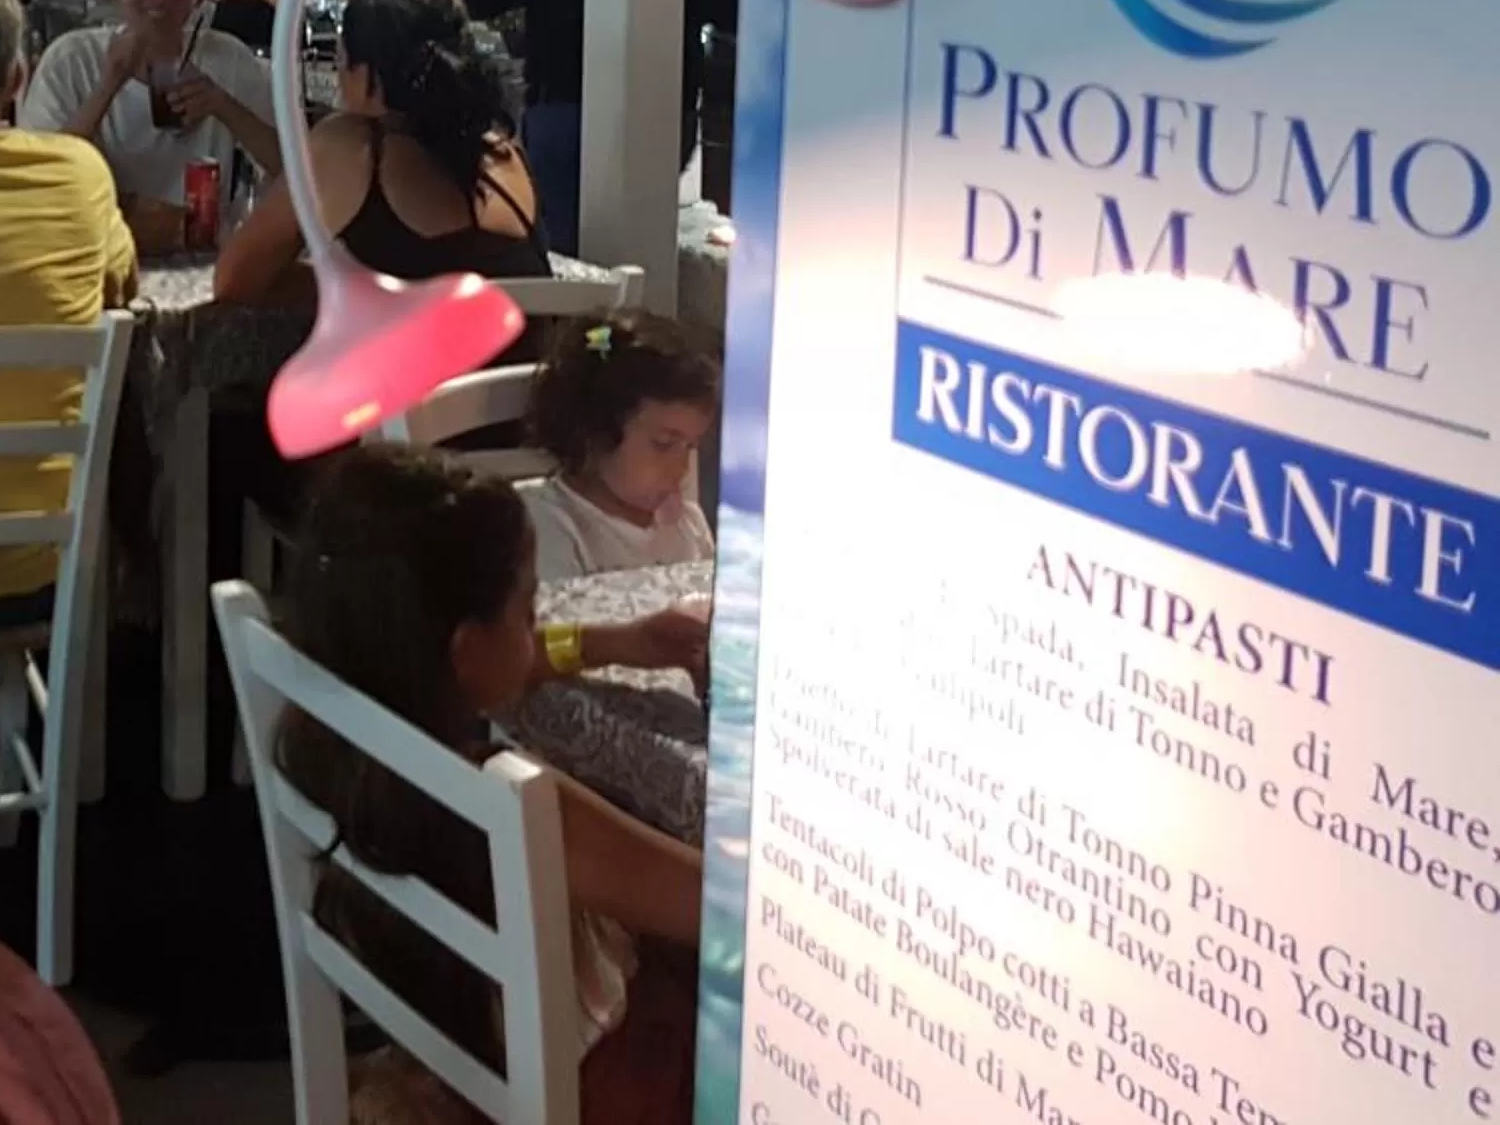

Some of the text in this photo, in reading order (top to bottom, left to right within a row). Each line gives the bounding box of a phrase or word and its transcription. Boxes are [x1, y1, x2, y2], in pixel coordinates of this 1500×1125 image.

[935, 40, 1492, 241] PROFUMO
[915, 344, 1477, 613] RISTORANTE
[1026, 542, 1336, 708] ANTIPASTI
[1084, 689, 1116, 732] di
[1129, 705, 1248, 794] Tonno
[1259, 779, 1280, 809] e
[1292, 785, 1500, 915] Gambero
[1118, 651, 1256, 748] Insalata
[1293, 730, 1332, 781] di
[1368, 761, 1500, 863] Mare,
[761, 894, 846, 982] Plateau
[855, 964, 880, 1006] di
[890, 984, 966, 1068] Frutti
[976, 1048, 1005, 1093] di
[762, 840, 804, 885] con
[812, 863, 887, 938] Patate
[896, 916, 1058, 1051] Boulangère
[1067, 1040, 1084, 1068] e
[765, 790, 874, 888] Tentacoli
[881, 869, 906, 907] di
[915, 885, 996, 963] Polpo
[1003, 951, 1070, 1013] cotti
[1079, 998, 1095, 1028] a
[1105, 1002, 1201, 1094] Bassa
[904, 760, 987, 831] Rosso
[1006, 818, 1172, 938] Otrantino
[1196, 933, 1264, 992] con
[1291, 970, 1438, 1090] Yogurt
[1468, 1085, 1493, 1120] e
[905, 803, 931, 841] di
[943, 832, 995, 875] sale
[1005, 865, 1076, 925] nero
[1088, 901, 1269, 1038] Hawaiano
[1017, 786, 1048, 827] di
[1061, 804, 1172, 893] Tonno
[1188, 870, 1300, 965] Pinna
[1318, 944, 1450, 1047] Gialla
[1471, 1037, 1497, 1070] e
[754, 1023, 821, 1100] Soutè
[826, 1083, 851, 1125] di
[757, 962, 922, 1109] Cozze Gratin
